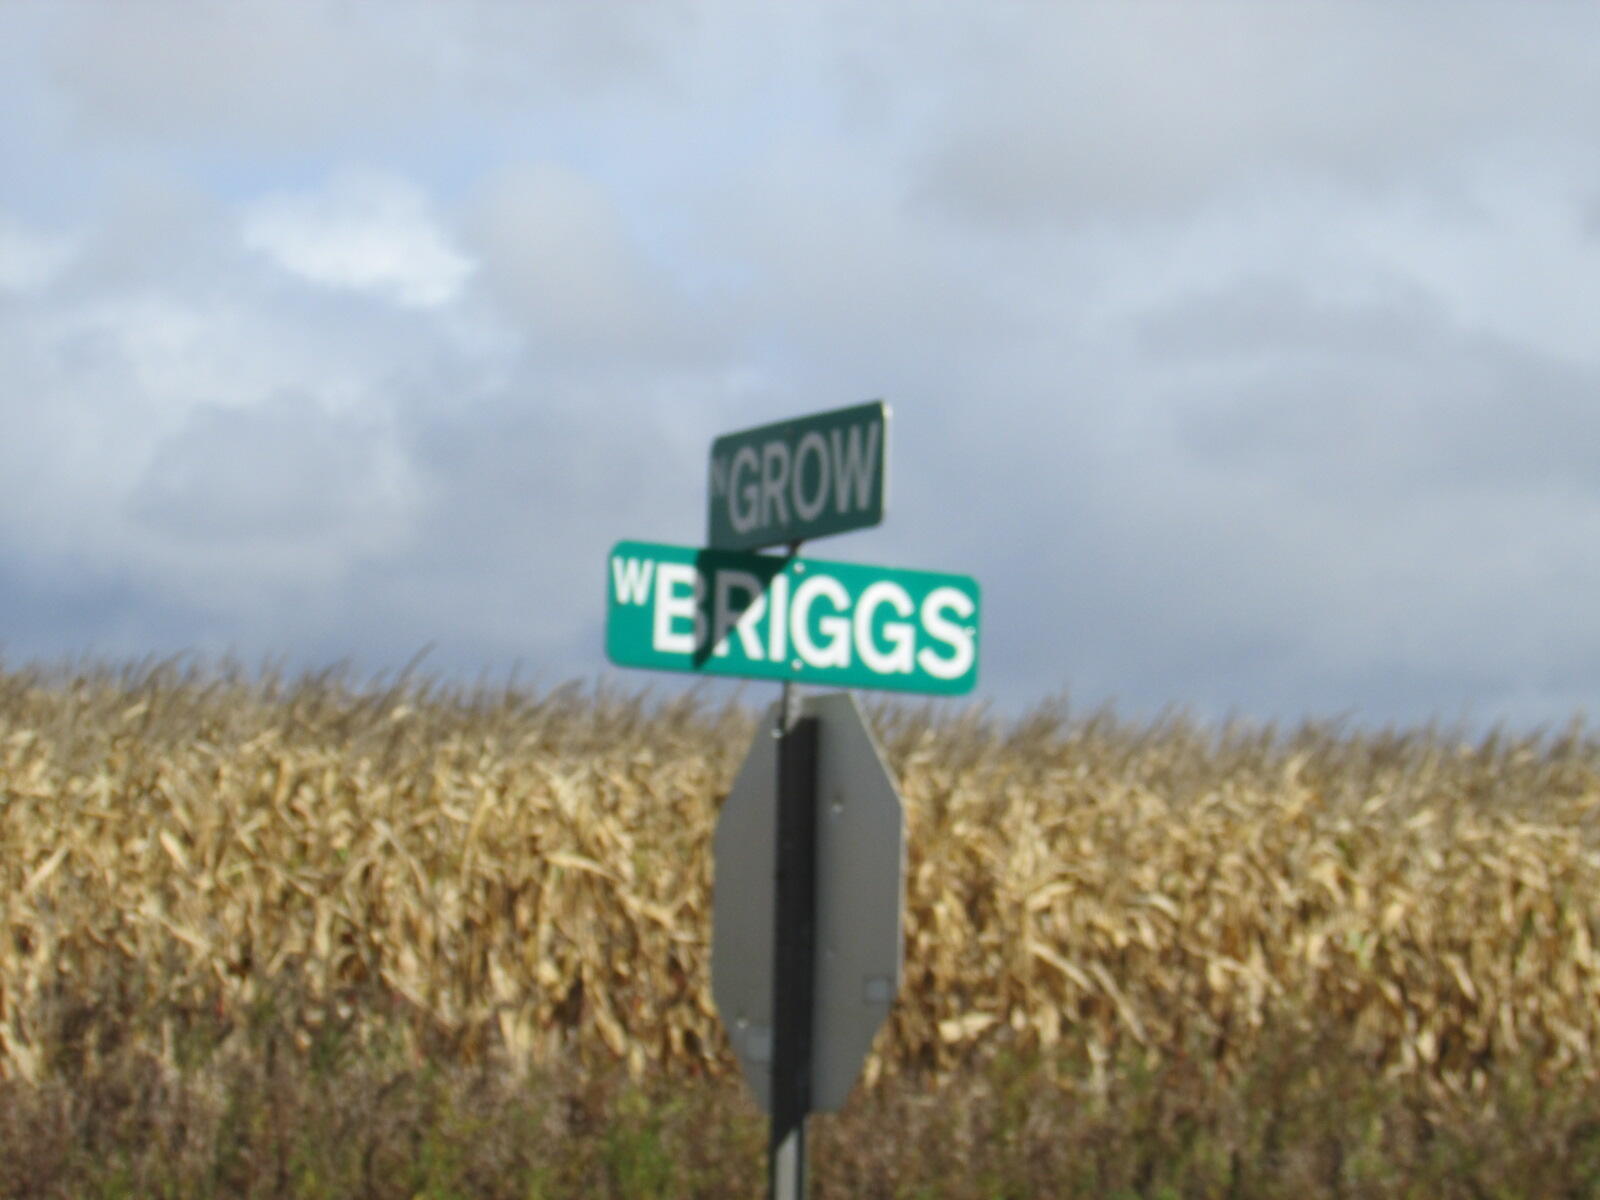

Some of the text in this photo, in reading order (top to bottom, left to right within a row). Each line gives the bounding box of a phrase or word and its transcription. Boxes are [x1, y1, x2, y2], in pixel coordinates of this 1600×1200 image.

[728, 421, 881, 534] GROW
[612, 556, 975, 680] W BRIGGS
